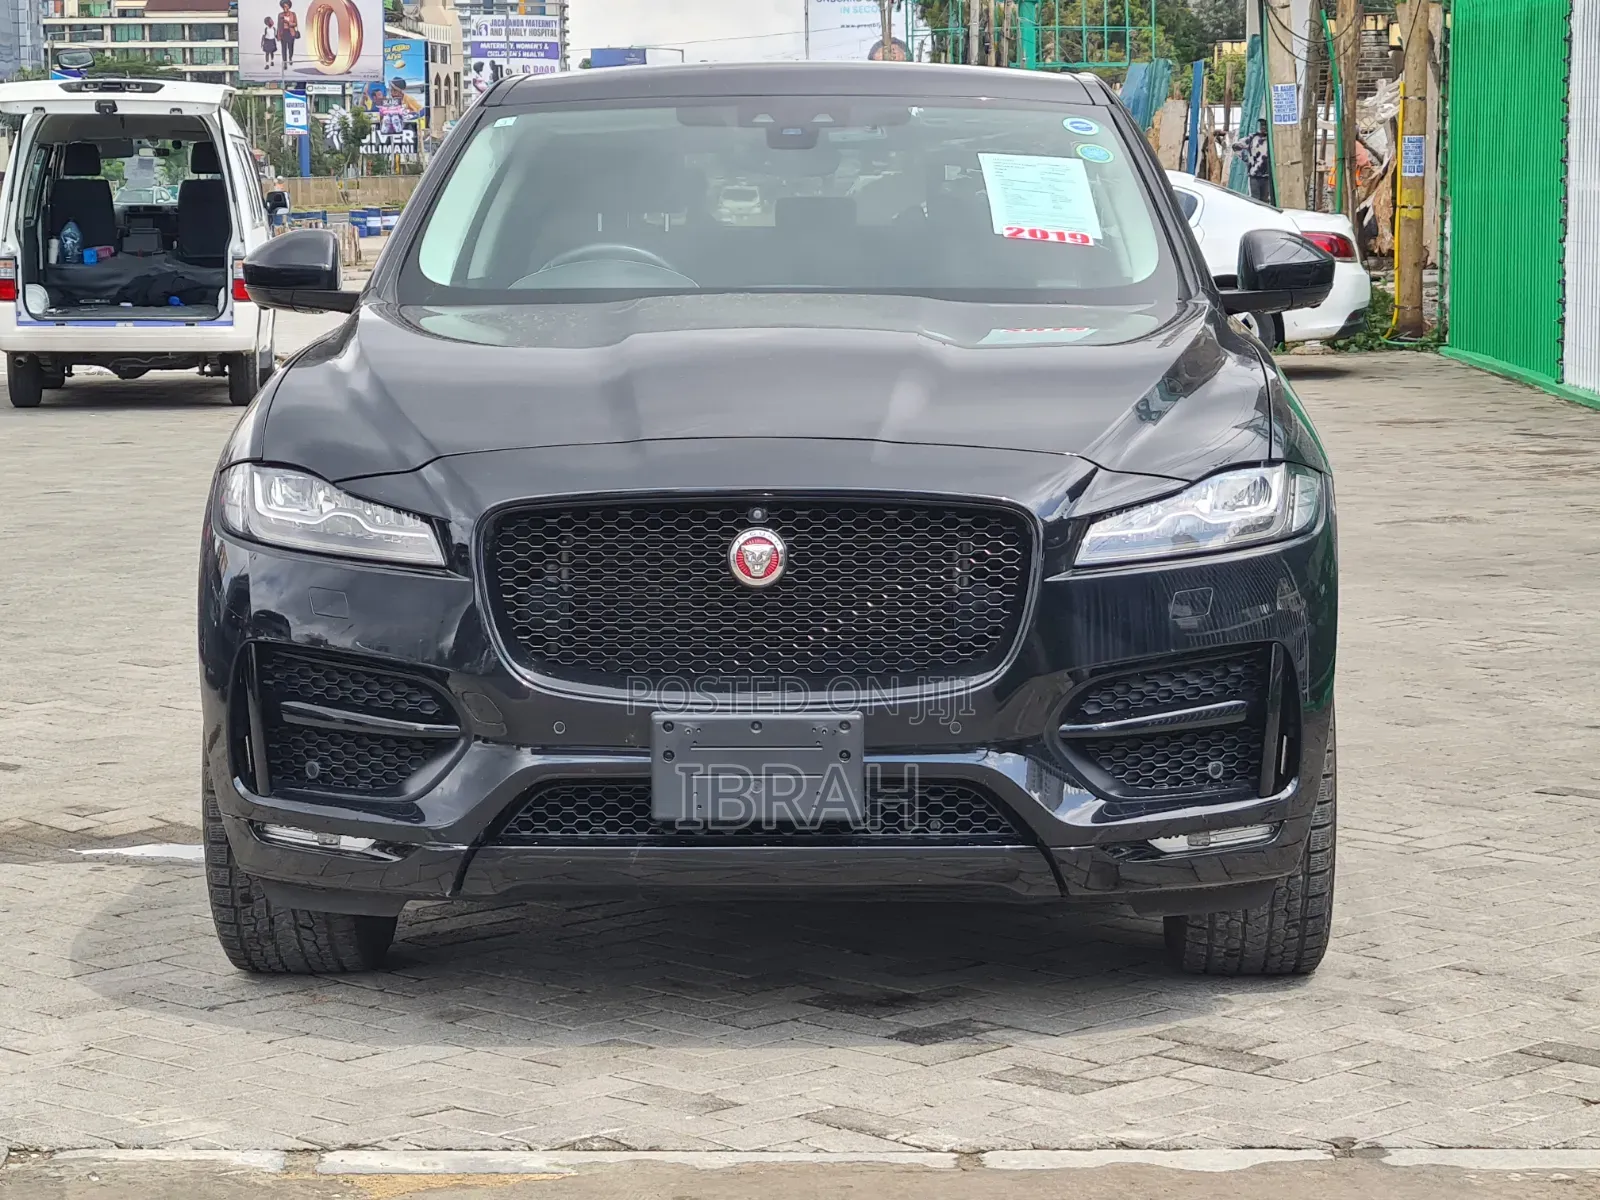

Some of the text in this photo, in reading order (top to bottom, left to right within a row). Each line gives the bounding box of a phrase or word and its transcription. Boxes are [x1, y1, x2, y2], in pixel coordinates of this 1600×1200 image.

[525, 19, 558, 28] MATERNITY
[490, 27, 503, 37] AND
[528, 28, 558, 37] HOSPITAL
[360, 144, 414, 154] KILIMANI
[1005, 226, 1090, 244] 2019
